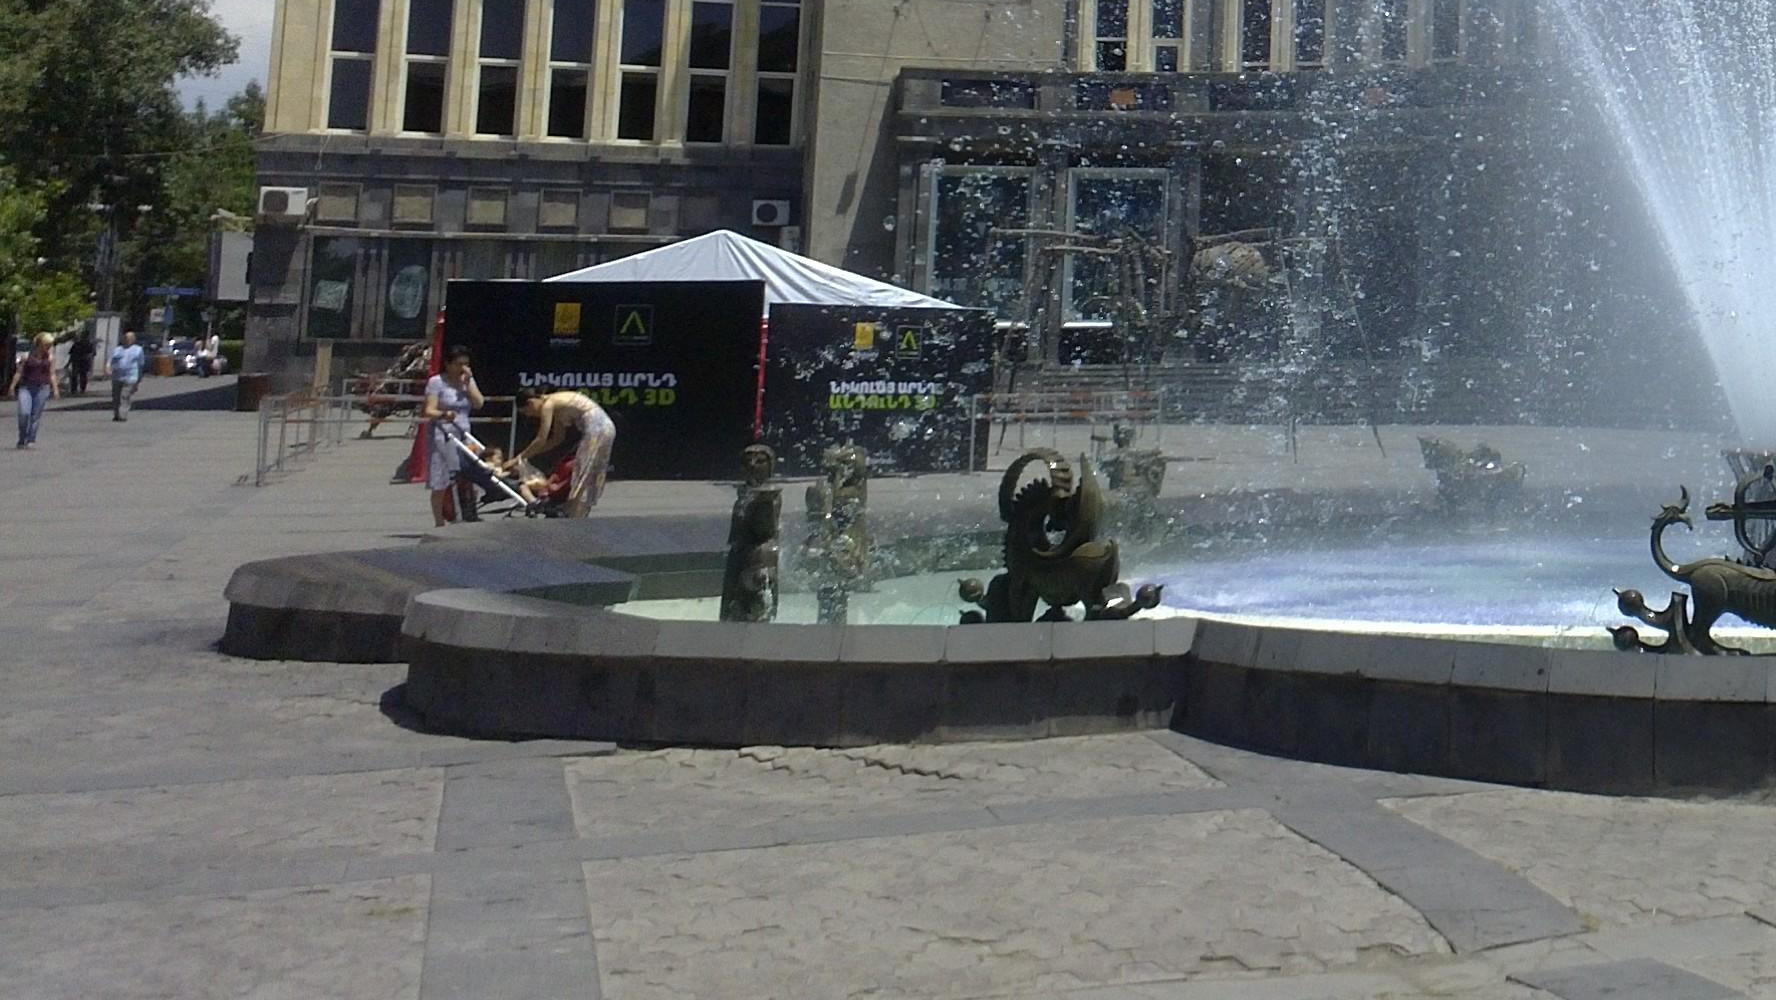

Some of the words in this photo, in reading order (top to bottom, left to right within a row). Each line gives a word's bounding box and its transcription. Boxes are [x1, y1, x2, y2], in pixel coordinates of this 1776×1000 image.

[518, 372, 614, 387] ՆԻԿՈԼԱՅ
[618, 372, 677, 387] ԱՐՆԴ
[643, 388, 677, 406] 3D
